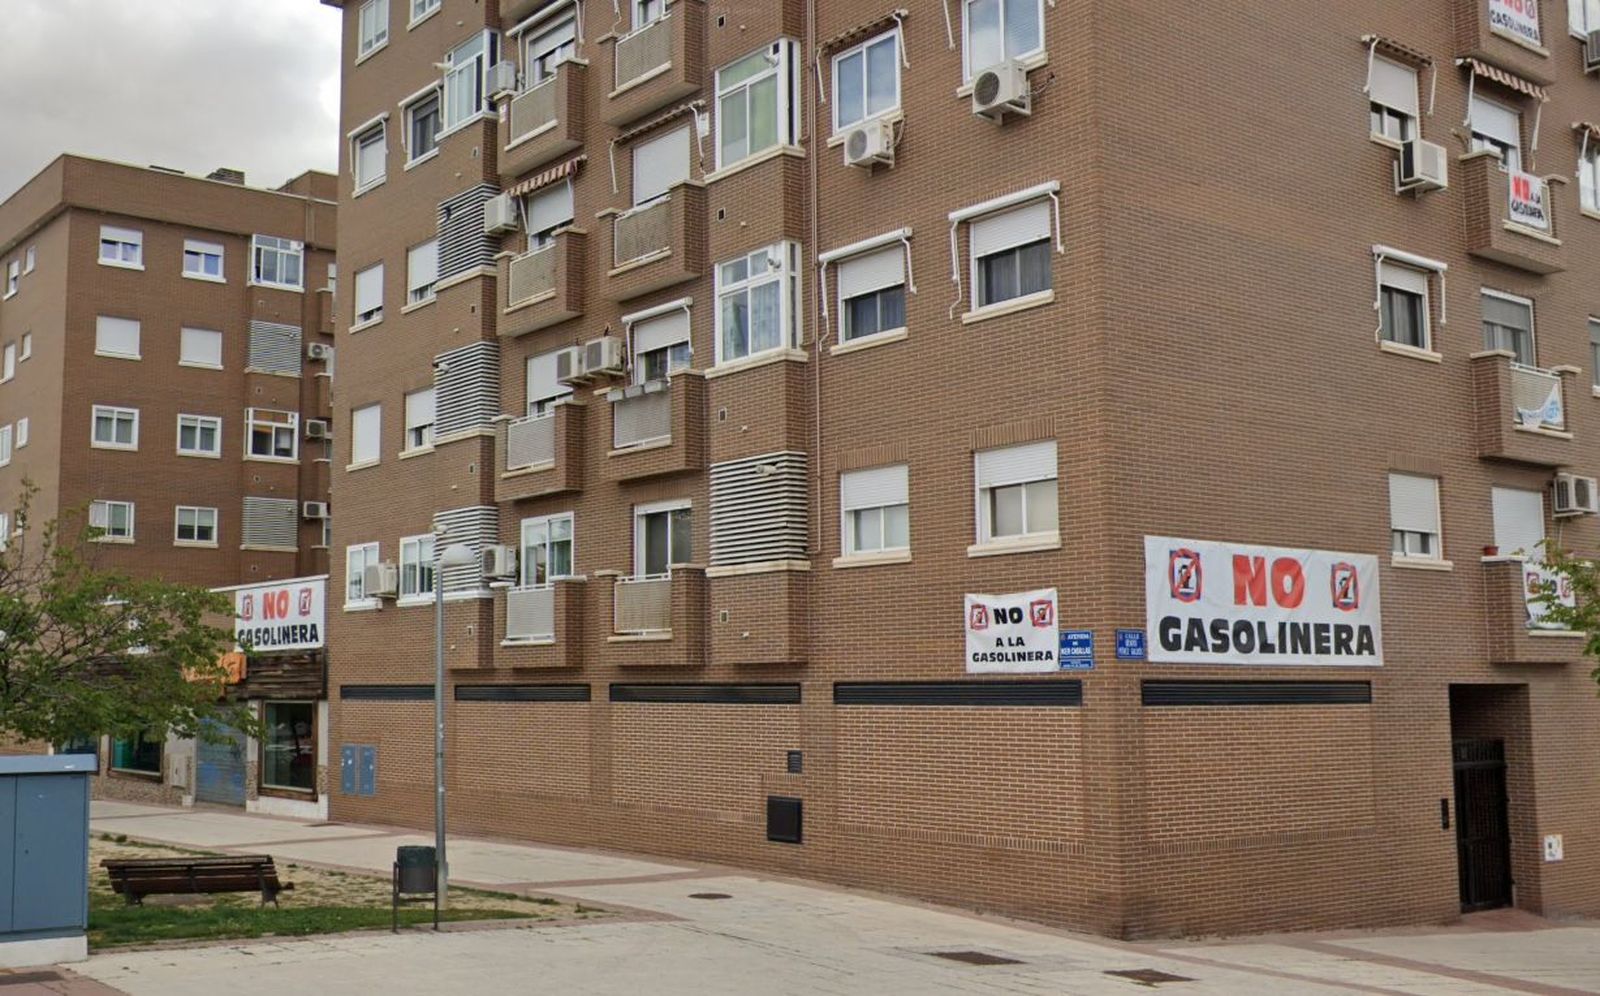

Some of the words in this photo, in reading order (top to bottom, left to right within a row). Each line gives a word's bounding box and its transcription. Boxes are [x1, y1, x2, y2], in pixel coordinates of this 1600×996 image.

[1232, 554, 1306, 609] NO
[262, 589, 290, 620] NO
[993, 607, 1023, 625] NO
[238, 623, 319, 646] GASOLINERA
[995, 637, 1004, 647] A
[1008, 636, 1025, 647] LA
[1159, 615, 1376, 656] GASOLINERA
[972, 650, 1053, 663] GASOLINERA
